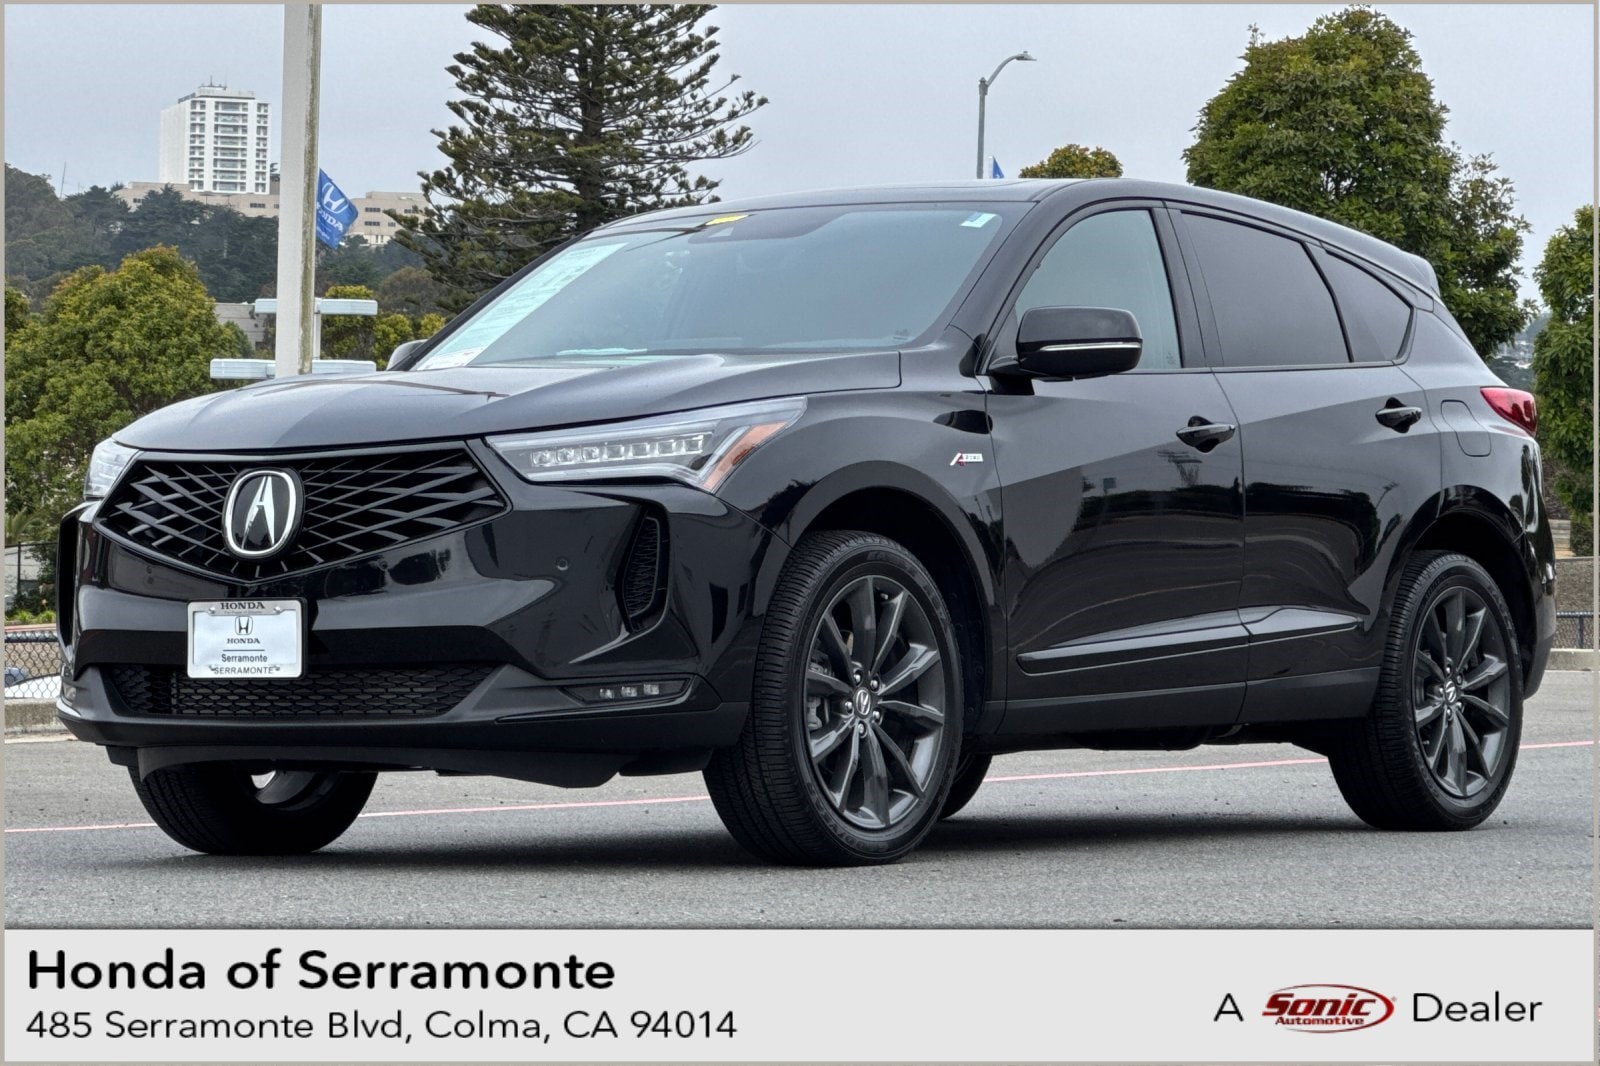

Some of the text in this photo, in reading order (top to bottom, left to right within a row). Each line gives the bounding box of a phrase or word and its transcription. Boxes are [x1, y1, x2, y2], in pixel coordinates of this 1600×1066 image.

[220, 602, 266, 610] HONDA
[221, 653, 268, 663] Serramonte
[214, 666, 274, 675] SERRAMONTE
